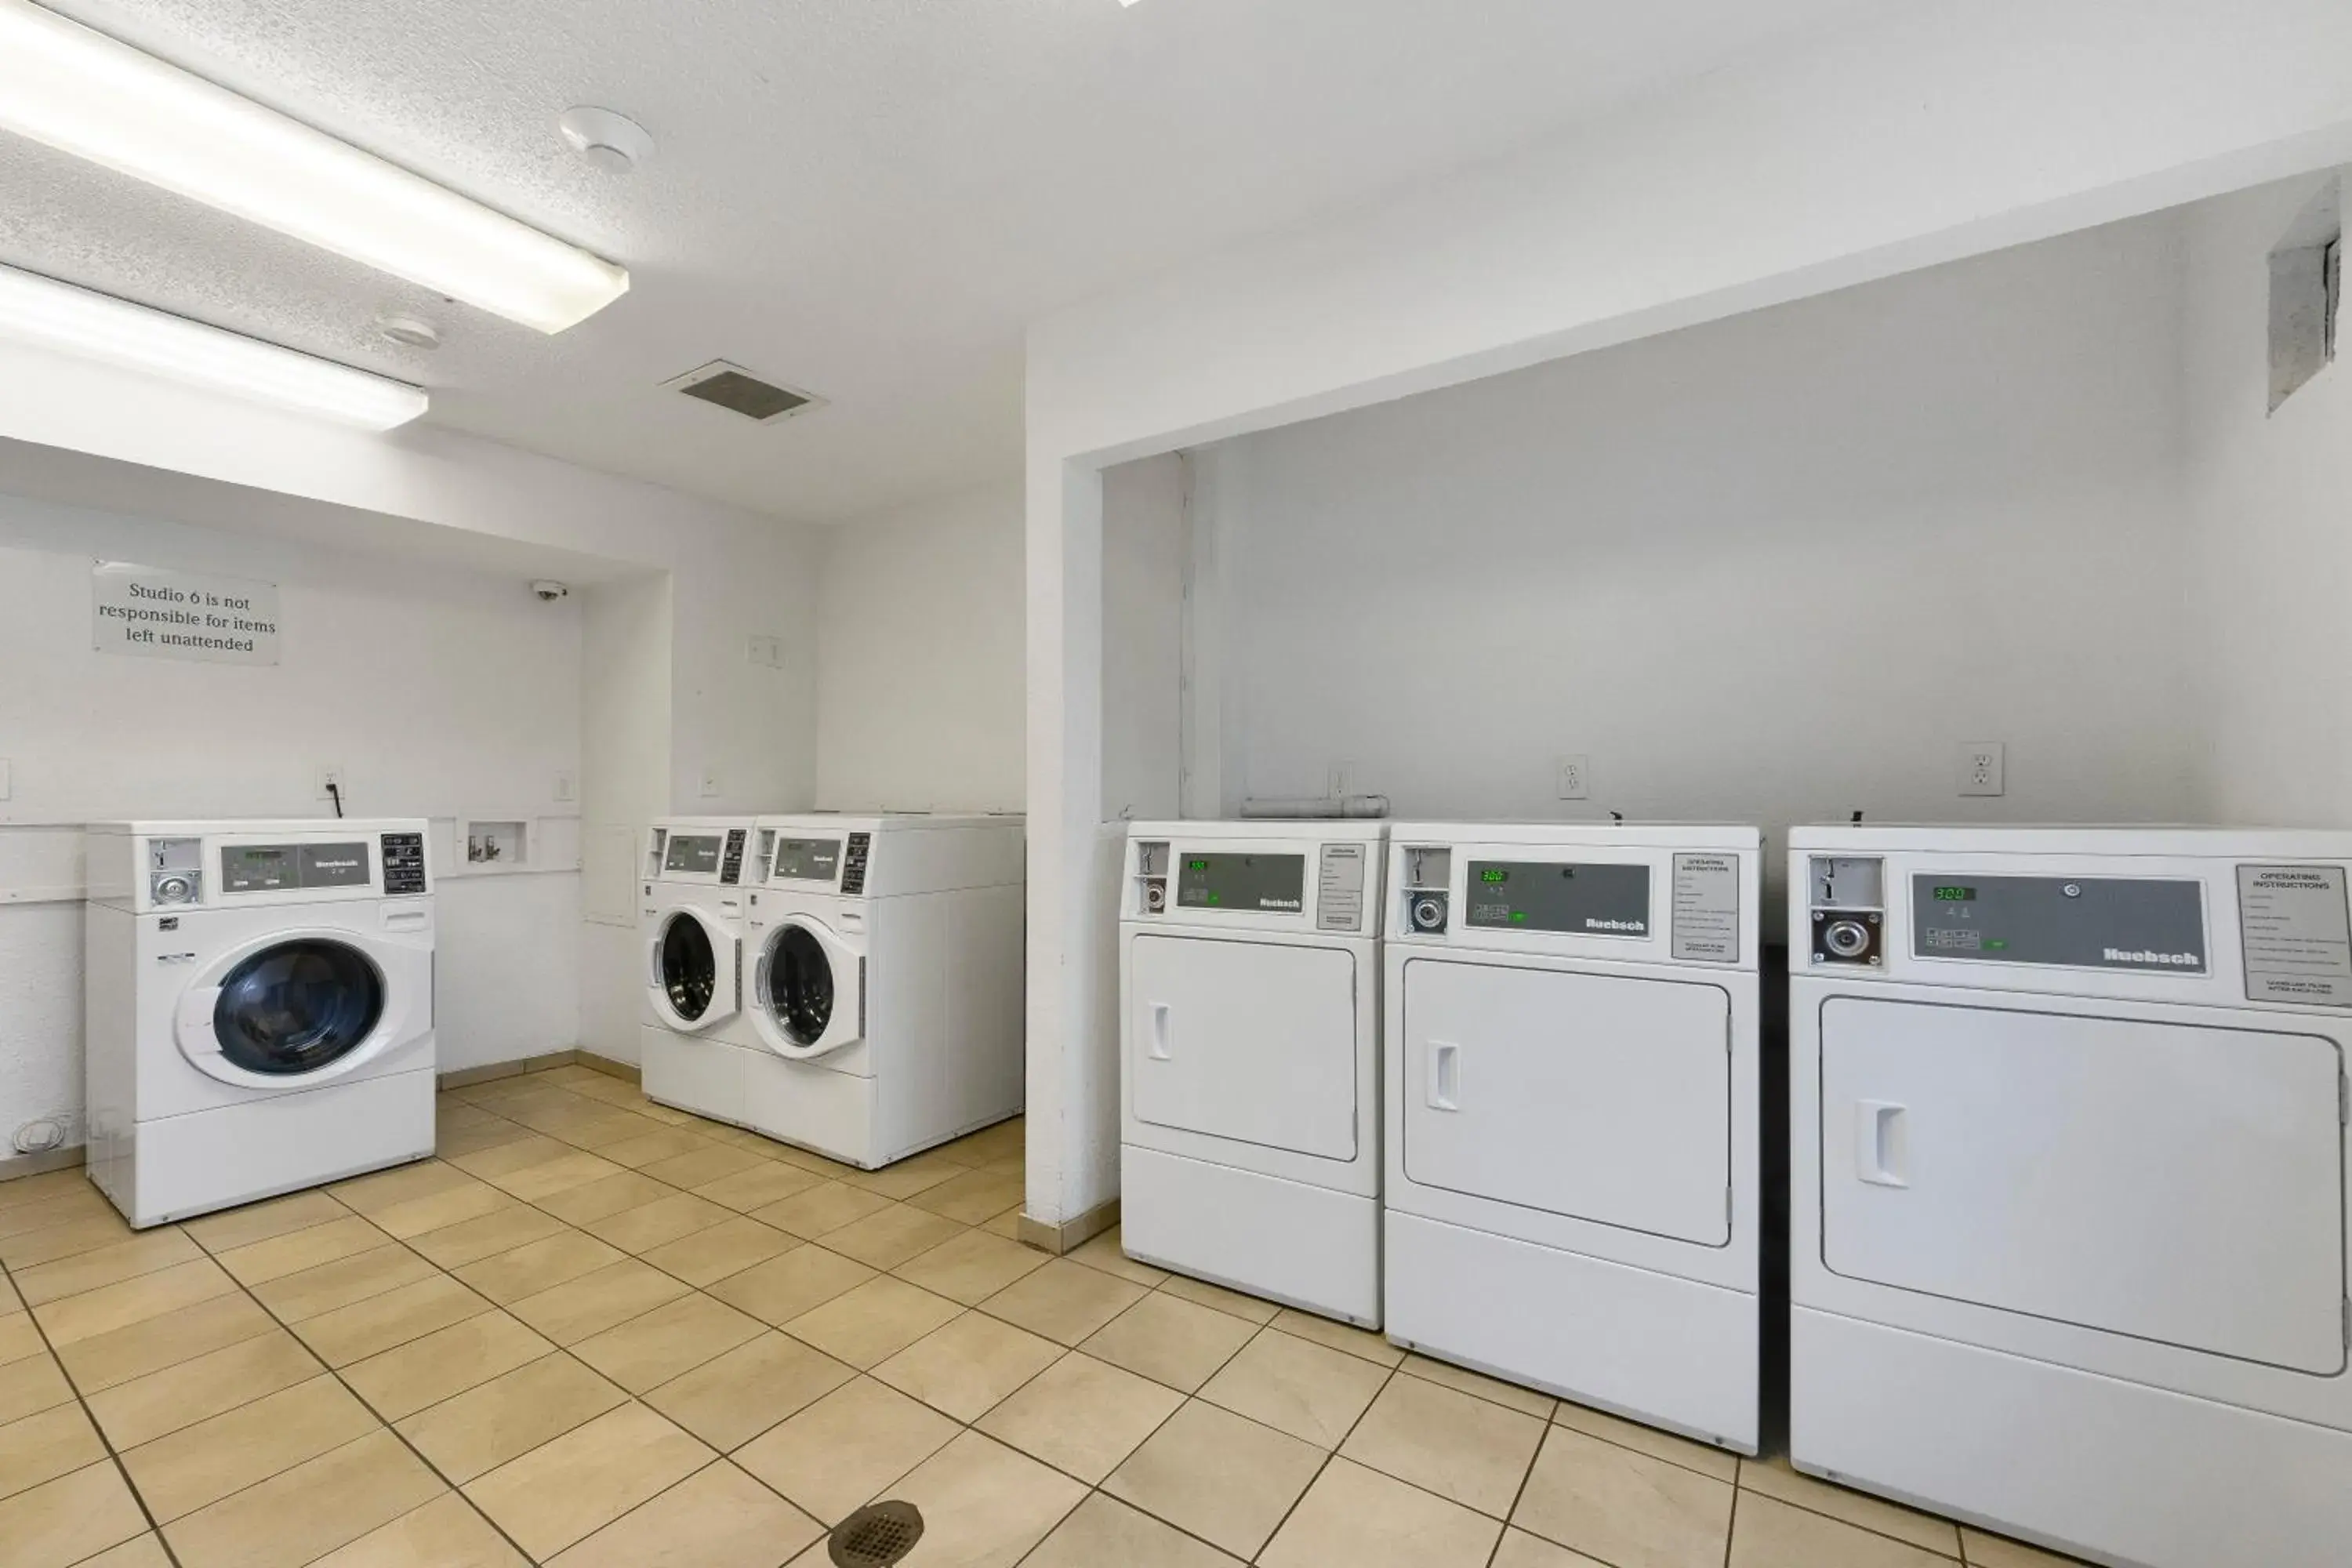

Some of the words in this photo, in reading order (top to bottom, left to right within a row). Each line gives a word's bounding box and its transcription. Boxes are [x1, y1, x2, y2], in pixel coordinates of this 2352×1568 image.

[129, 583, 184, 603] Studio
[190, 591, 200, 604] 6
[206, 593, 219, 607] is
[224, 597, 250, 611] not
[100, 604, 201, 626] responsible
[206, 614, 229, 629] for
[233, 617, 276, 633] items
[126, 628, 154, 643] left
[161, 633, 253, 652] unattended
[2103, 947, 2199, 965] Huebsch
